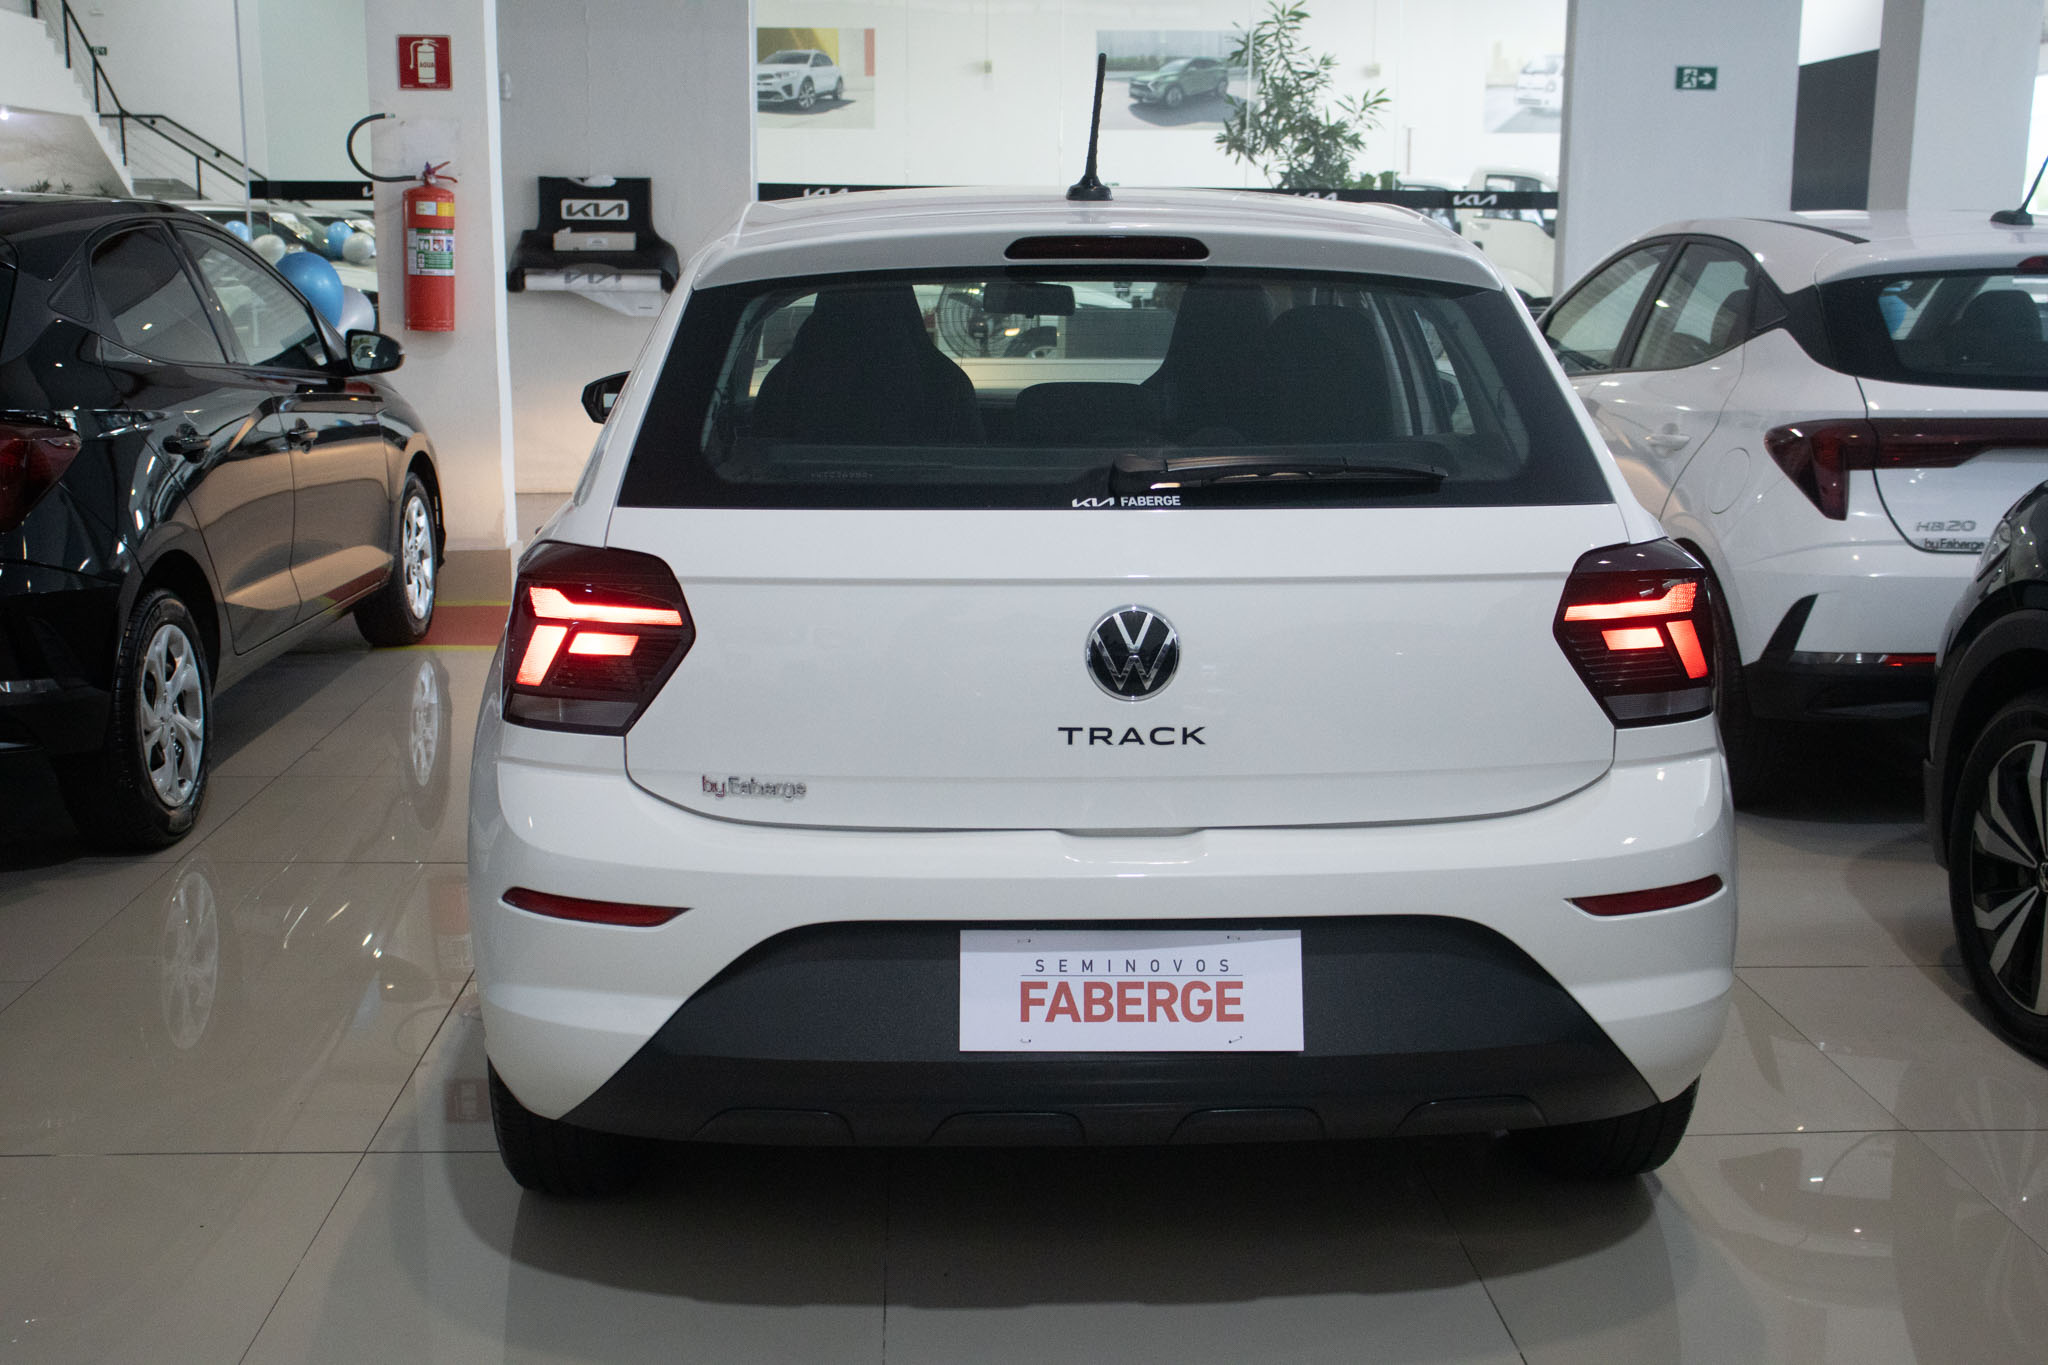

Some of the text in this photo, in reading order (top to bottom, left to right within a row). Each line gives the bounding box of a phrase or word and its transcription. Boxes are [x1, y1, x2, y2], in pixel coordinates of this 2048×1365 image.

[1453, 194, 1497, 206] KIA
[566, 202, 624, 217] KIA
[1072, 496, 1181, 507] KIA FABERGE
[1916, 520, 1977, 532] HB20
[1058, 727, 1206, 746] TRACK
[1035, 959, 1230, 973] SEMINOVOS
[1020, 981, 1244, 1023] FABERGE
